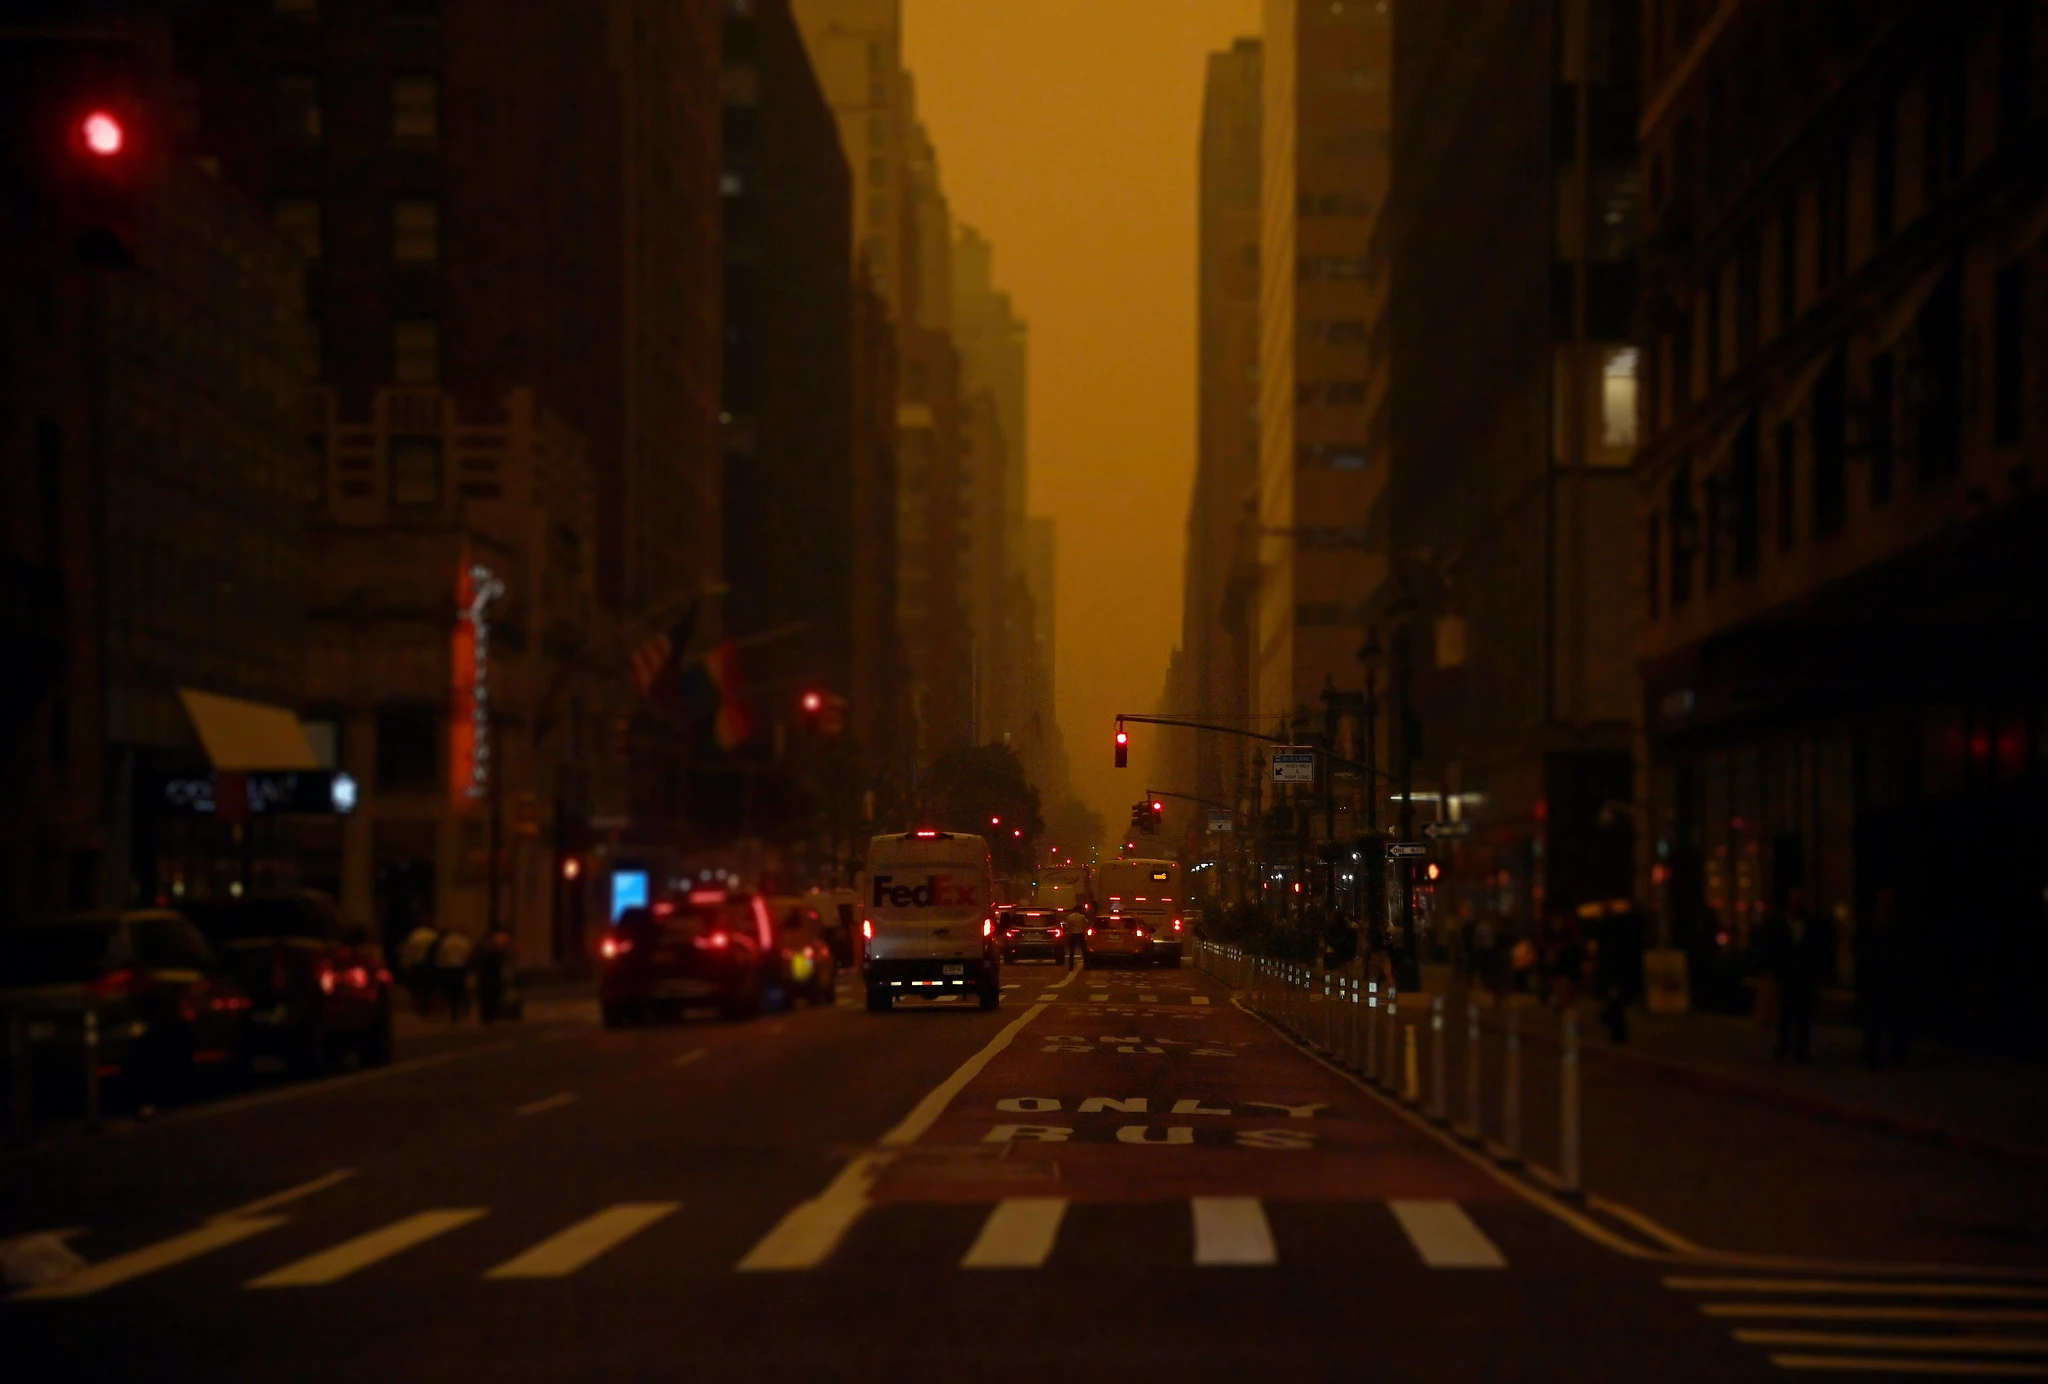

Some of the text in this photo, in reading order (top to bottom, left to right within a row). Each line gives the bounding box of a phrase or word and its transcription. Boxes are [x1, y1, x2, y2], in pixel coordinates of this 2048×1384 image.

[873, 875, 977, 908] FedEx
[995, 1097, 1331, 1118] ONLY
[983, 1124, 1319, 1149] BUS
